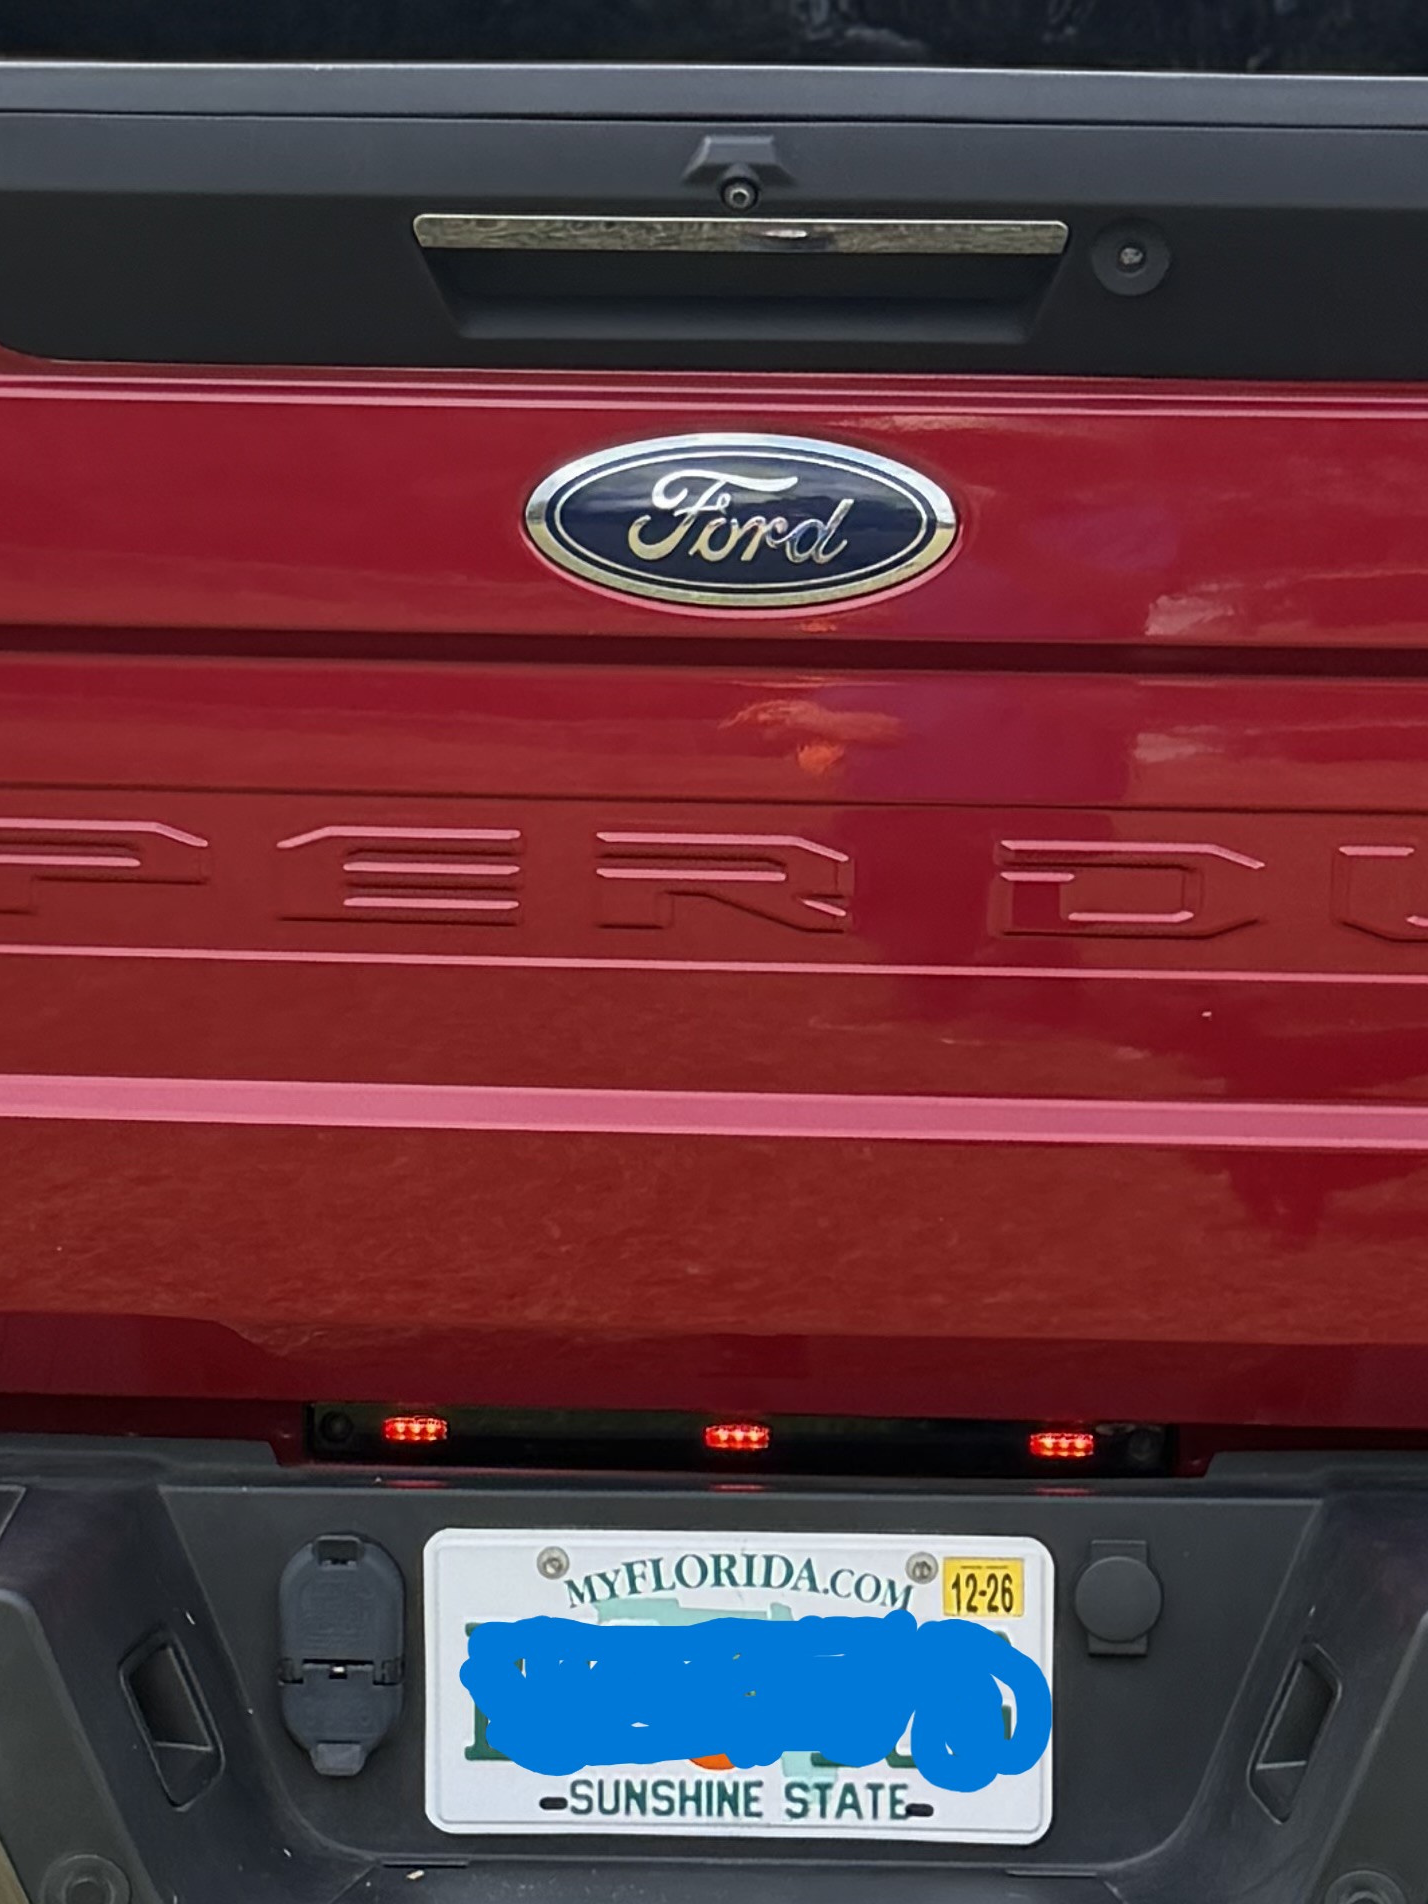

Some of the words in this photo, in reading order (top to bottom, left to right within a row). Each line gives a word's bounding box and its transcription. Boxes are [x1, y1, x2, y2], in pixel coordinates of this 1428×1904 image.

[628, 469, 854, 564] Ford
[563, 1552, 915, 1612] MYFLORIDA.COM
[951, 1573, 1014, 1616] 12-26
[569, 1778, 764, 1818] SUNSHINE
[783, 1782, 909, 1821] STATE
